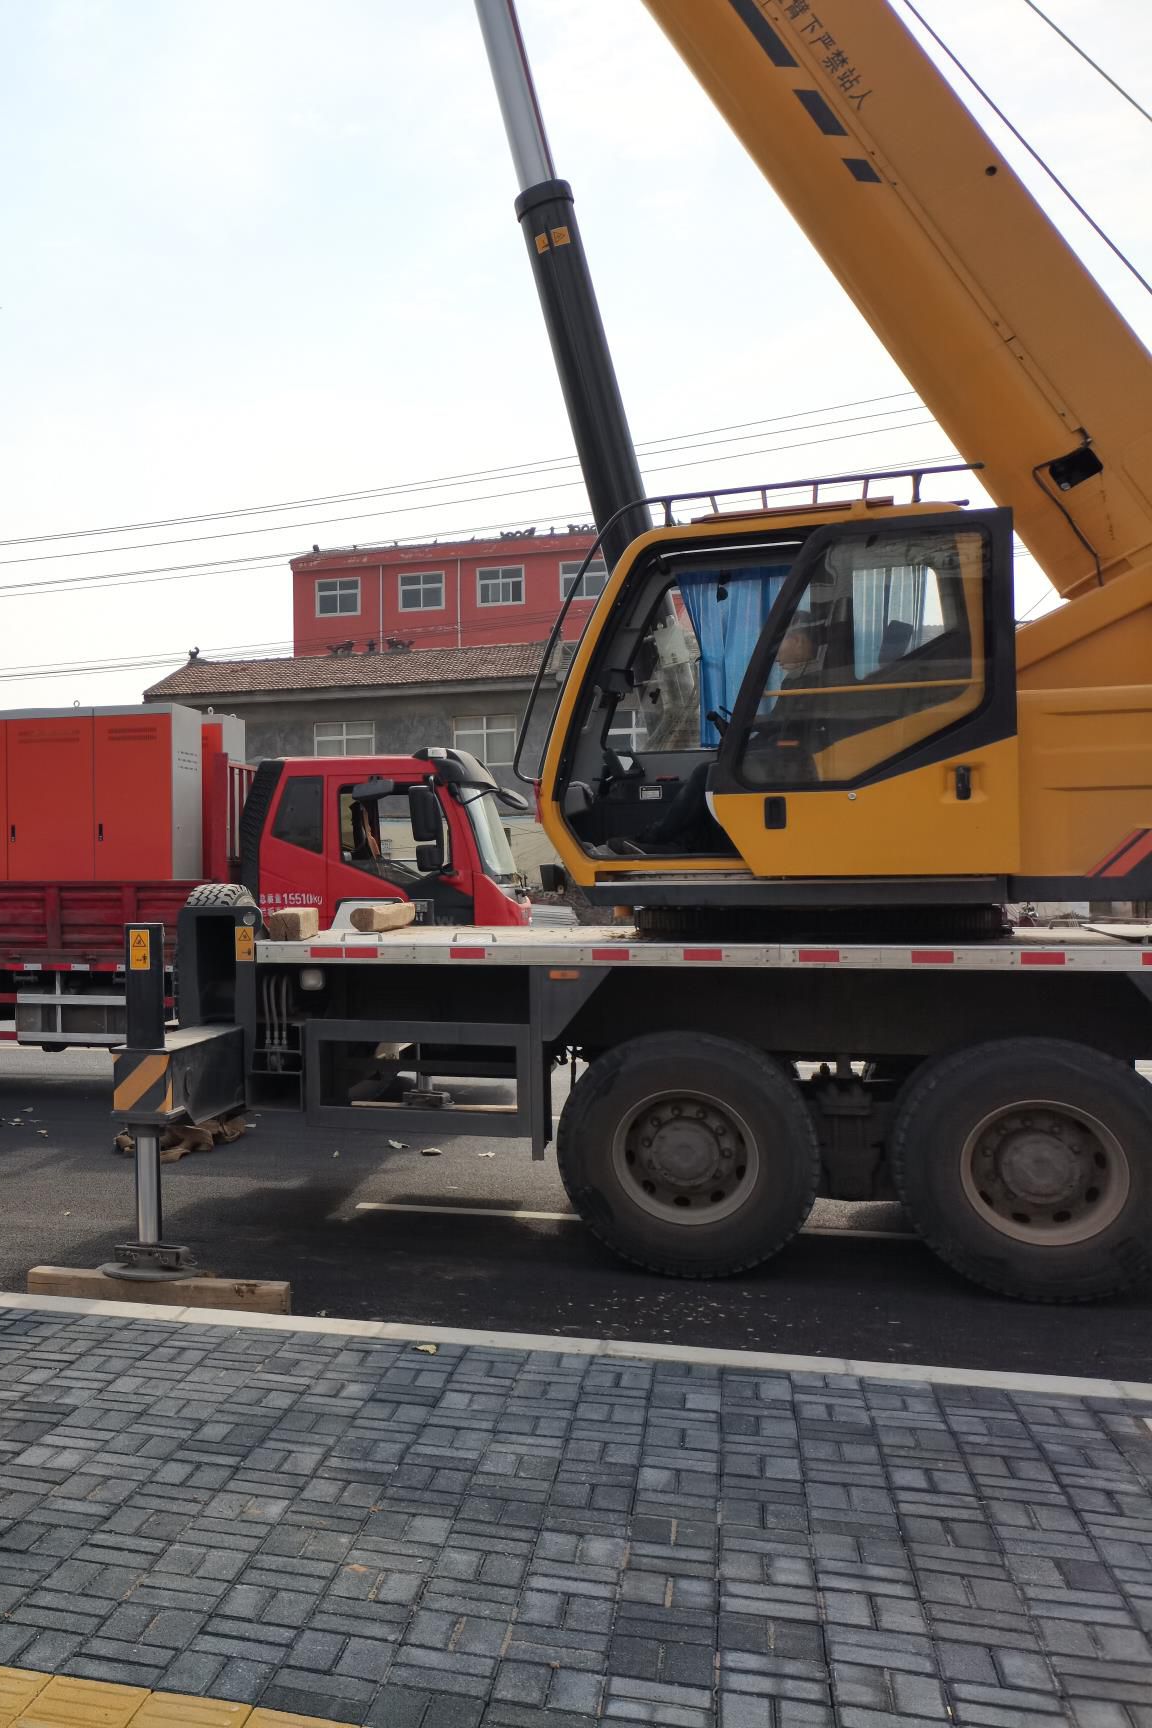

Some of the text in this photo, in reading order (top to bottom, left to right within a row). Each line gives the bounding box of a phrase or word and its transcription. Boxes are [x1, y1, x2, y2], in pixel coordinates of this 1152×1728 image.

[779, 0, 872, 111] 臂下严禁站人
